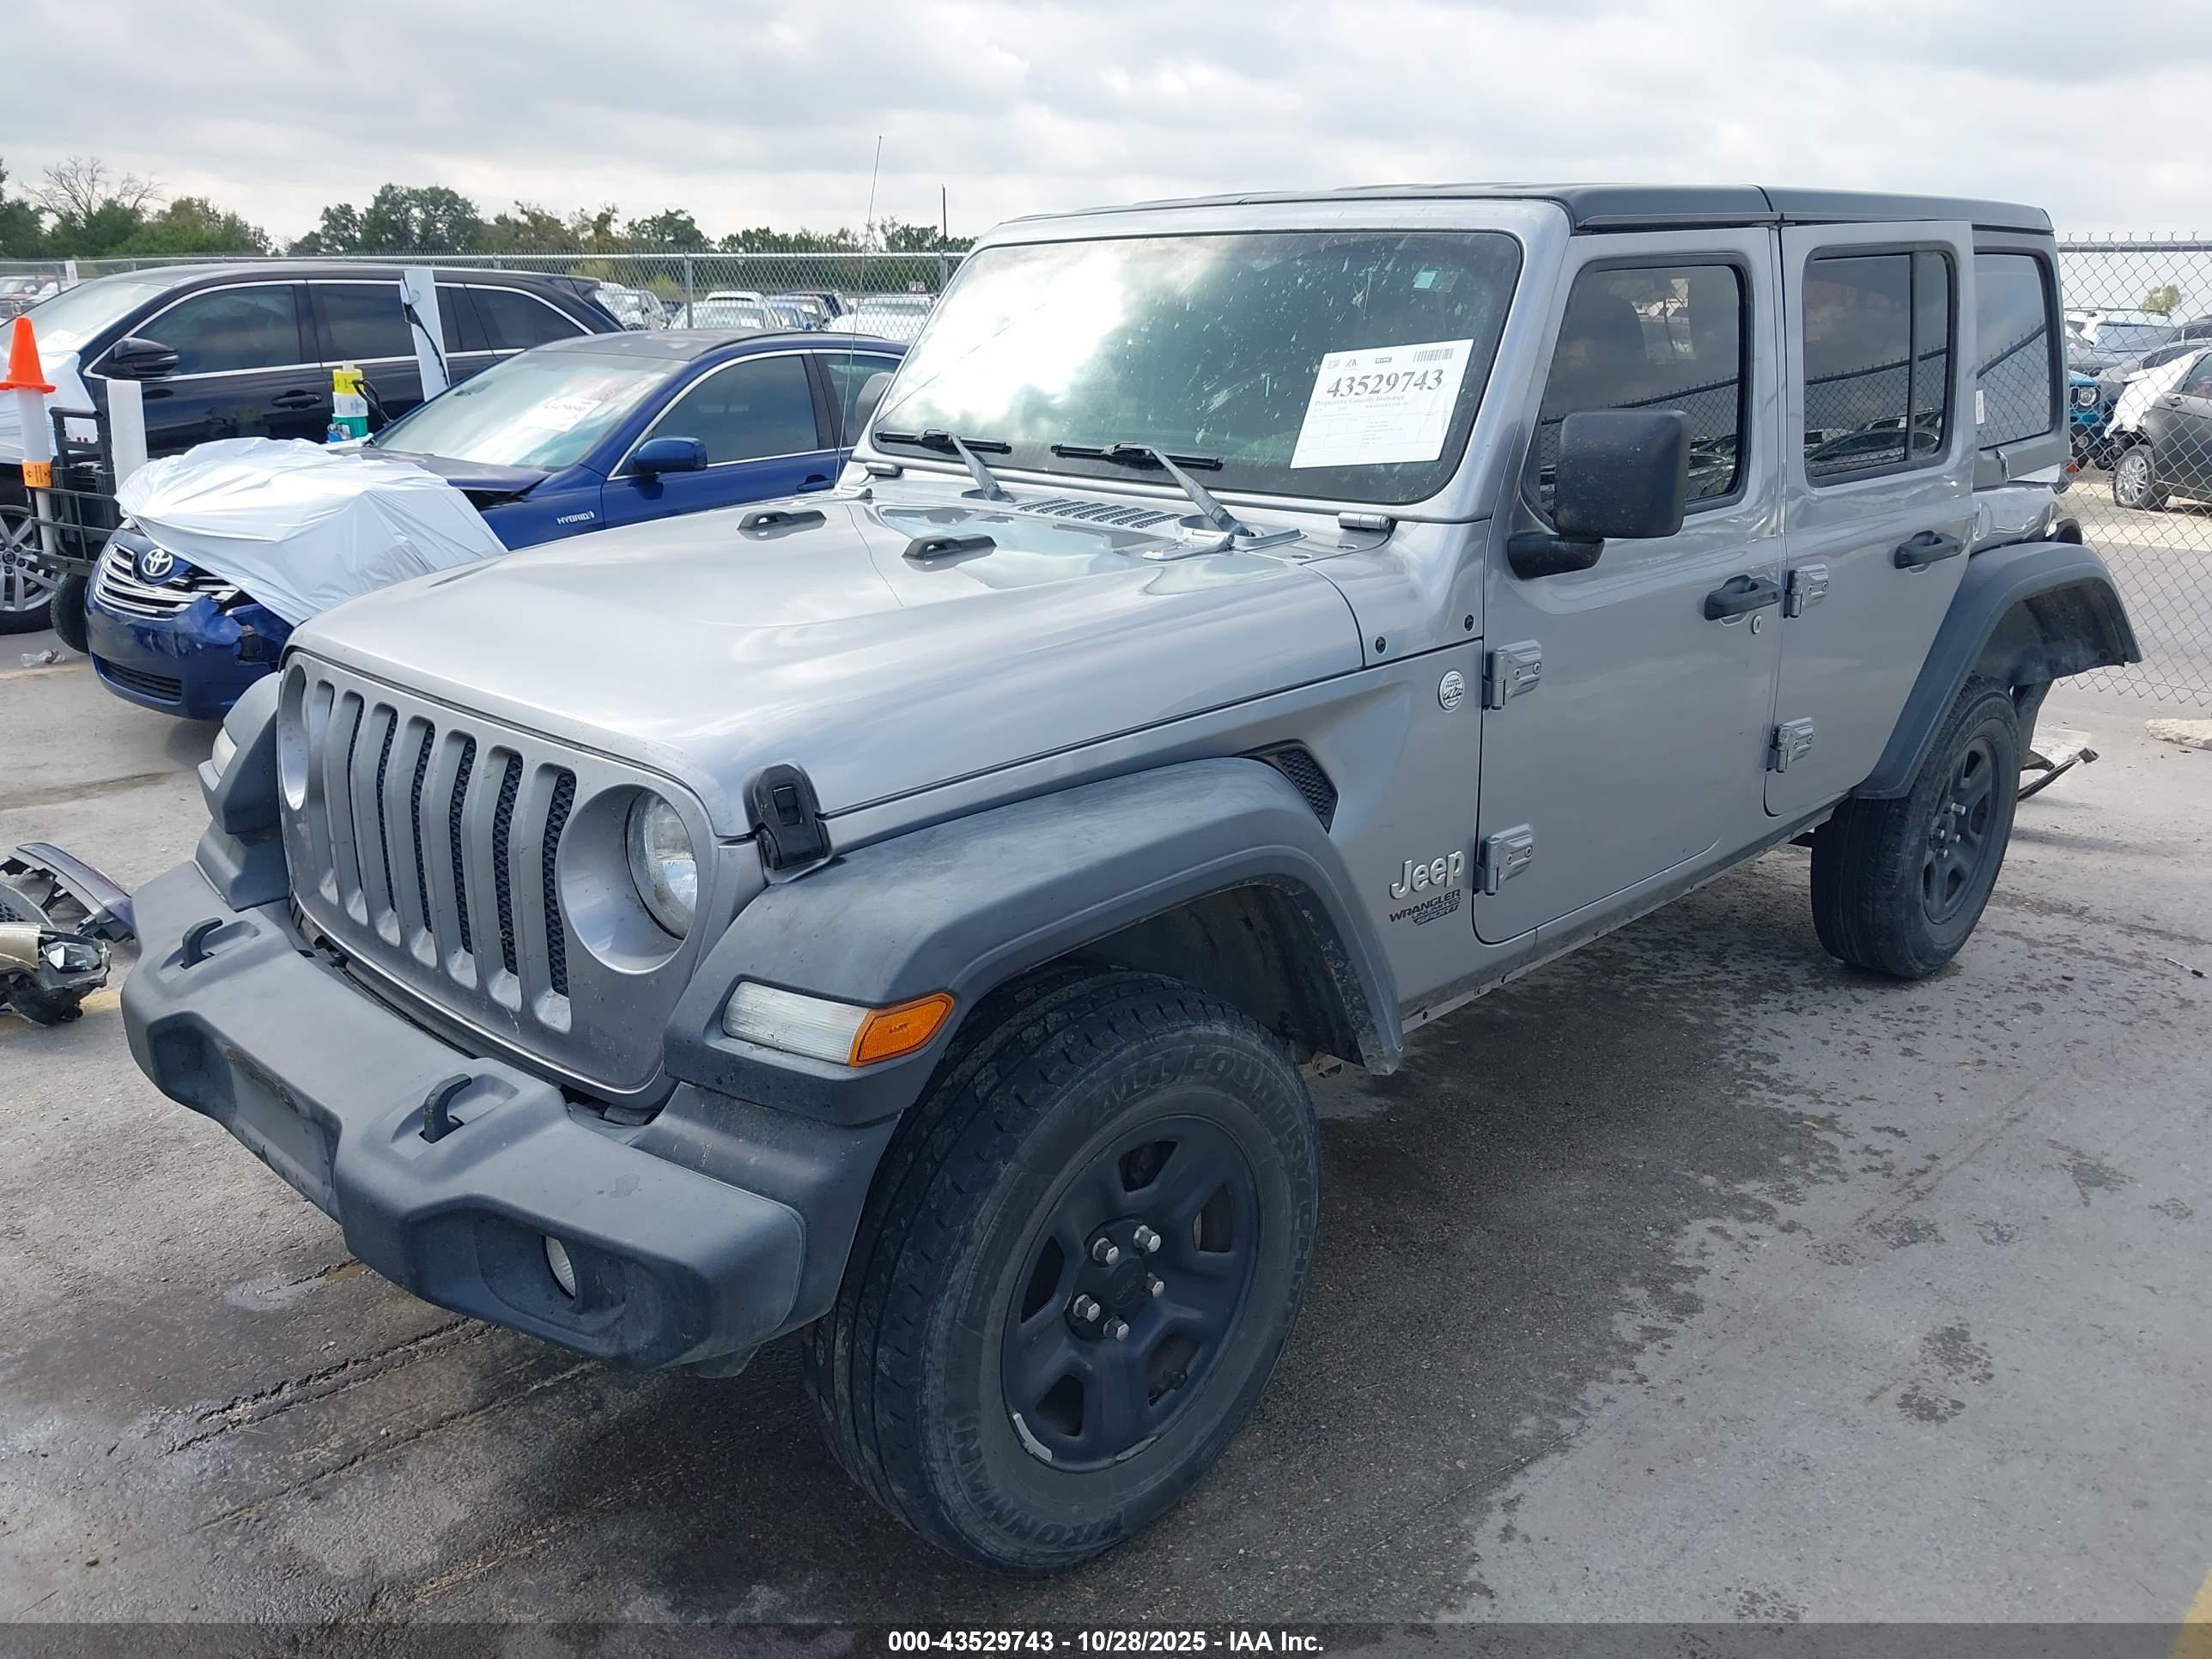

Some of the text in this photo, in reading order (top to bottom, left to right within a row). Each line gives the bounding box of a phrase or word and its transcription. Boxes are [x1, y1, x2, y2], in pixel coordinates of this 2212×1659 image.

[1327, 368, 1444, 398] 43529743
[556, 513, 591, 525] HYBRID
[1389, 850, 1465, 900] Jeep
[1389, 889, 1461, 923] WRANGLER
